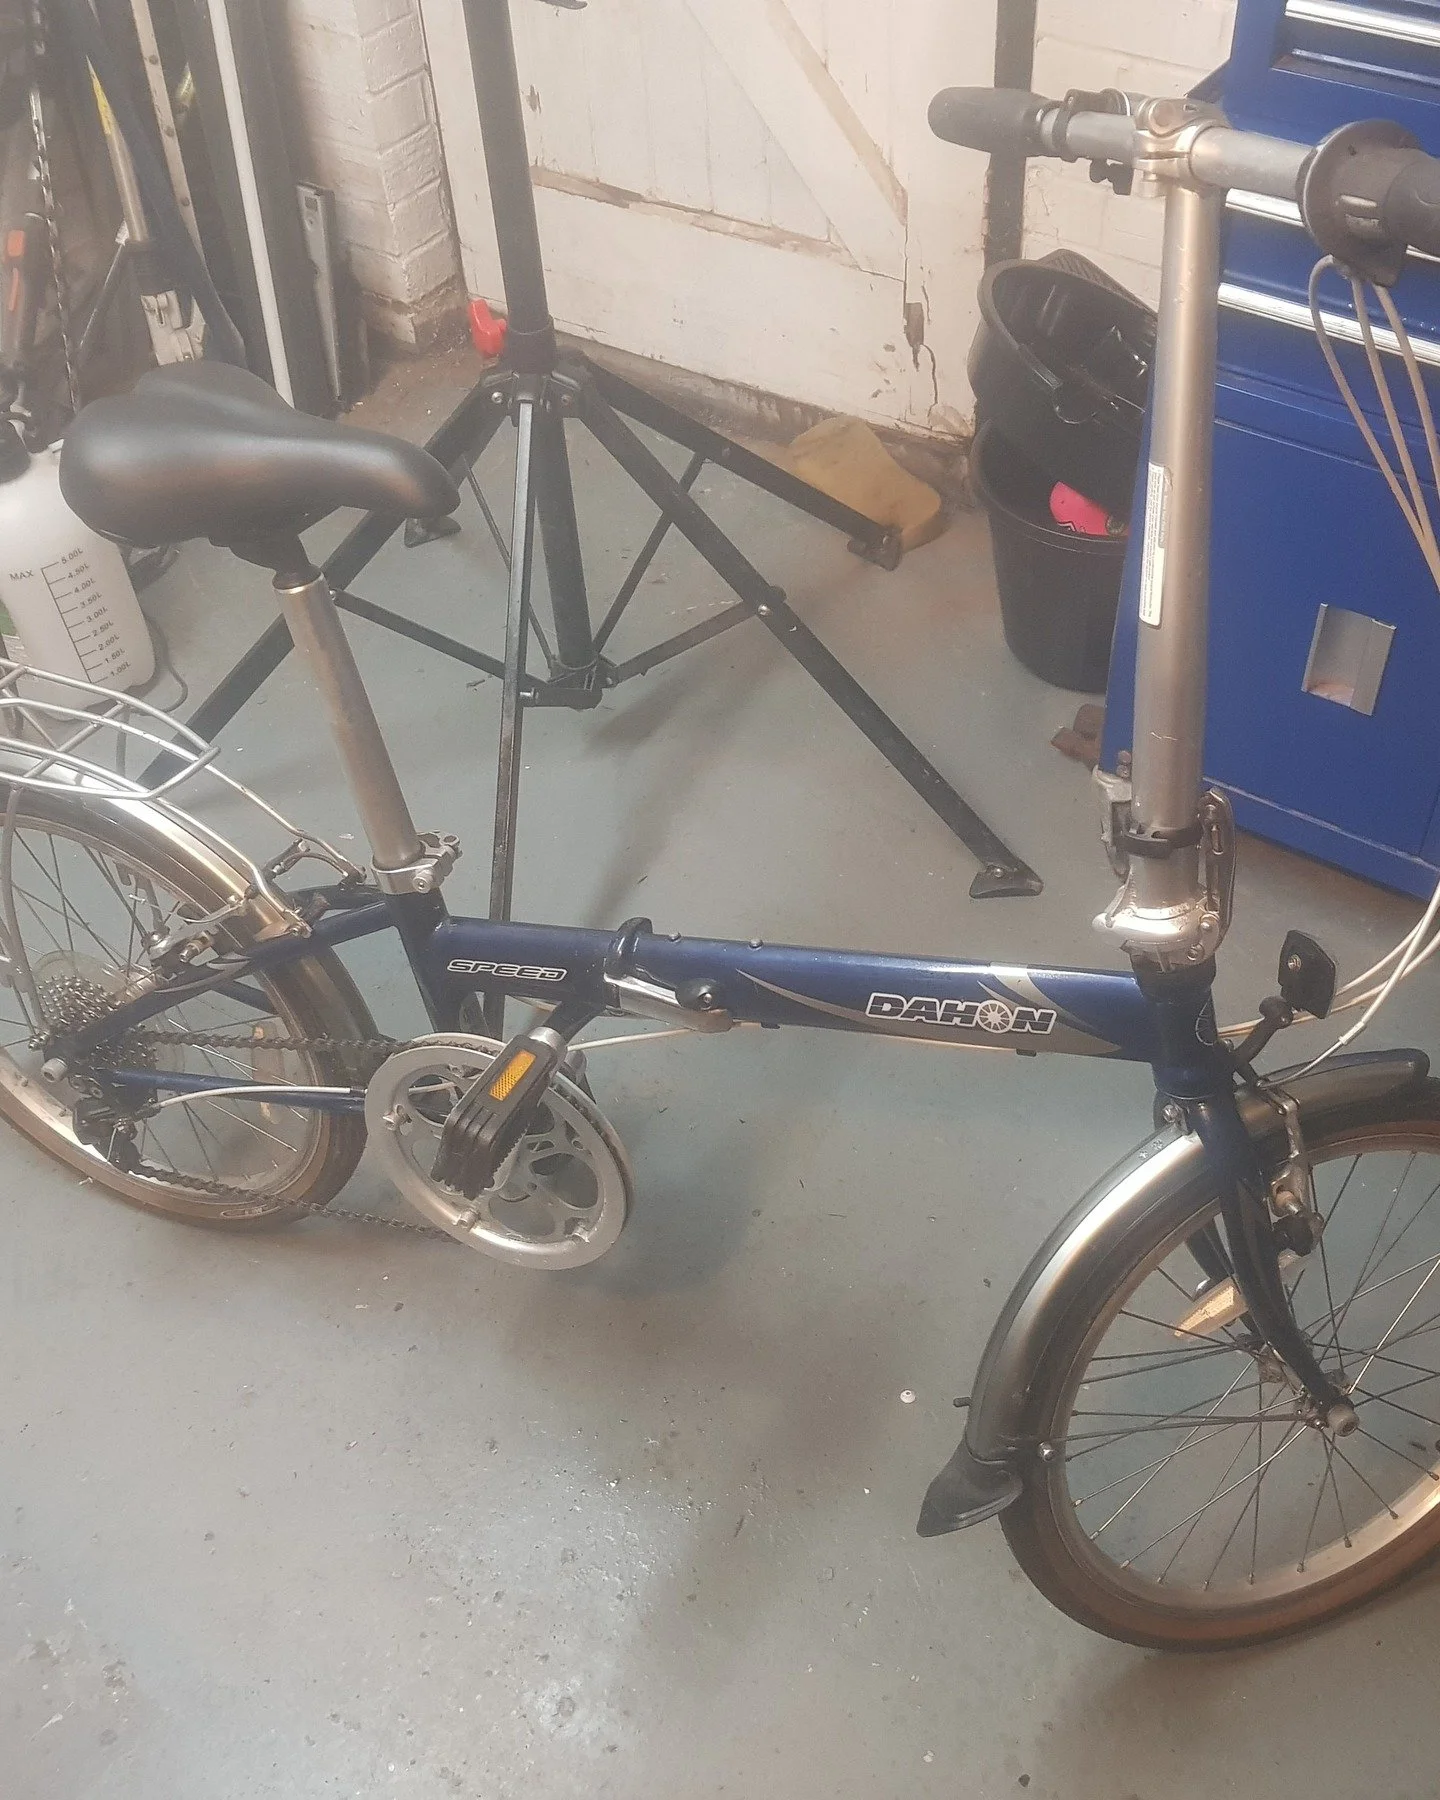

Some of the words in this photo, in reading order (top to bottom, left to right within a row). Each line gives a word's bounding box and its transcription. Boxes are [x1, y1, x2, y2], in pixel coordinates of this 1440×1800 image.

[61, 547, 84, 564] 5.00L
[8, 569, 34, 581] MAX
[67, 562, 90, 579] 4.50L
[73, 577, 96, 594] 4.00L
[80, 592, 103, 609] 3.50L
[86, 607, 109, 623] 3.00L
[91, 621, 115, 637] 2.50L
[98, 634, 121, 651] 2.00L
[104, 648, 126, 664] 1.50L
[110, 661, 132, 677] 1.00L
[446, 959, 568, 982] SPEED
[865, 992, 1057, 1034] DAHON
